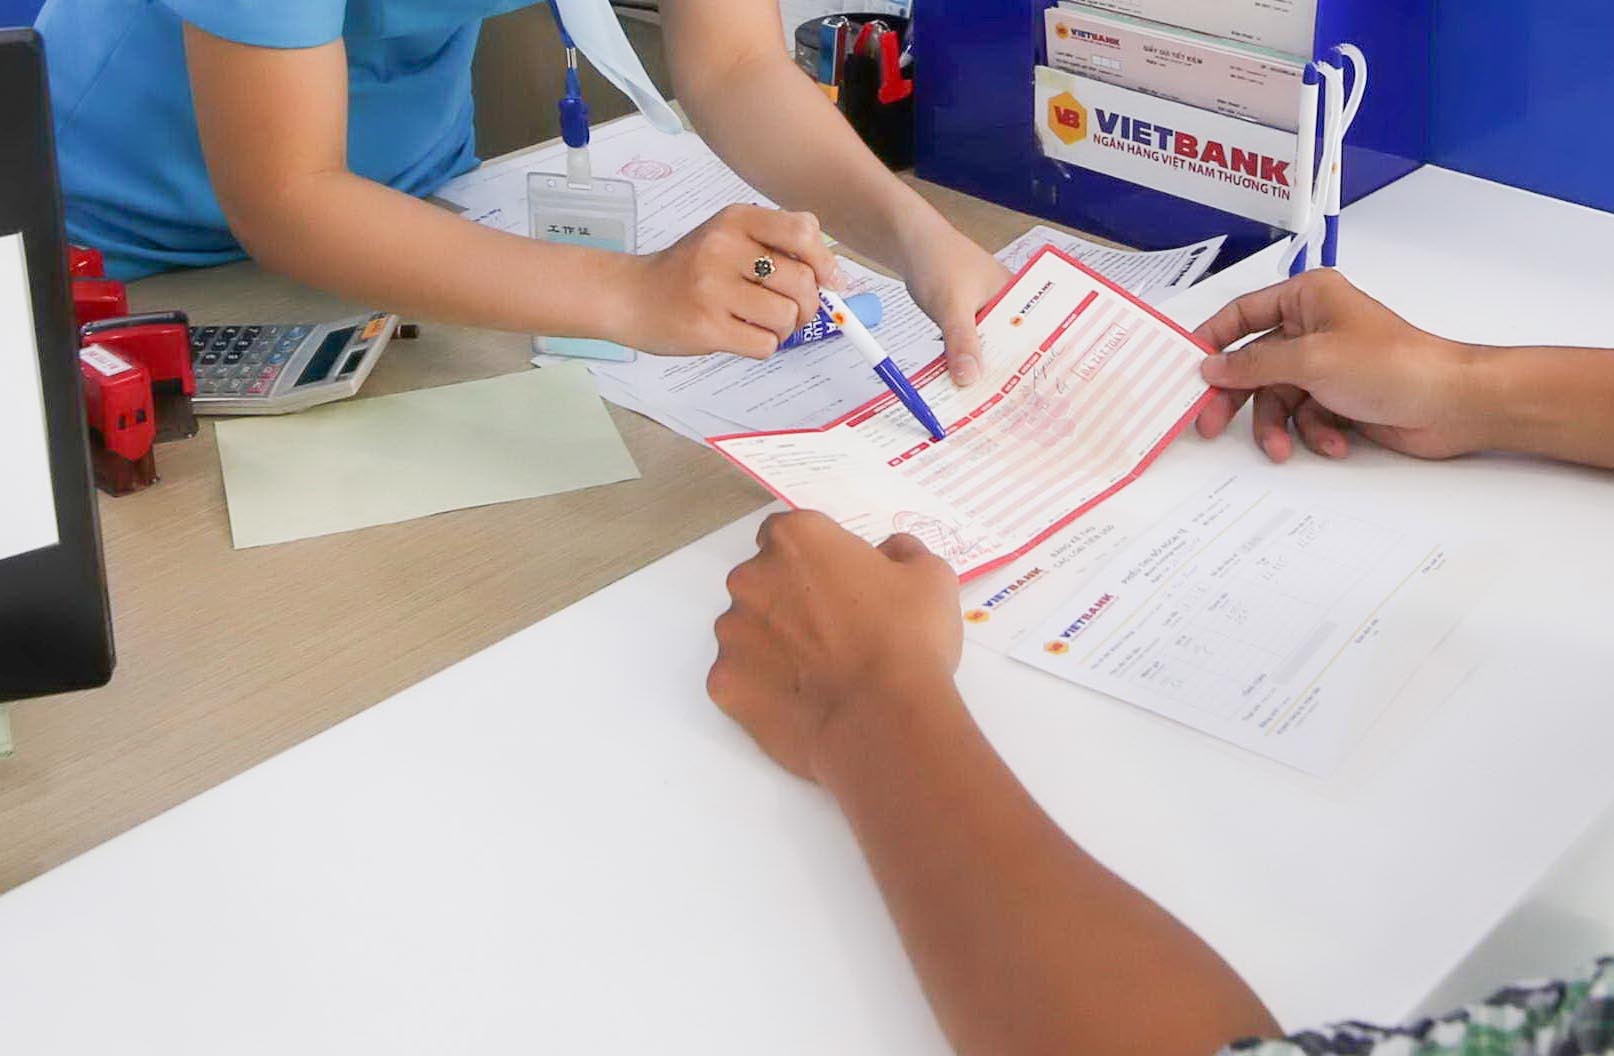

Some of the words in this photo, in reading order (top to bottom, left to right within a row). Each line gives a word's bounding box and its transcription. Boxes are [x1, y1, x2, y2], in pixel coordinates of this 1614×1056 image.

[1093, 133, 1125, 152] NGÂN
[1127, 140, 1160, 162] HÀNG
[1161, 152, 1185, 173] VIỆT
[1188, 161, 1216, 179] NAM
[1217, 170, 1269, 195] THƯƠNG
[1271, 184, 1291, 201] TÍN
[1095, 108, 1290, 186] VIETBANK
[982, 567, 1043, 607] VIETBANK
[1059, 593, 1114, 638] VIETBANK
